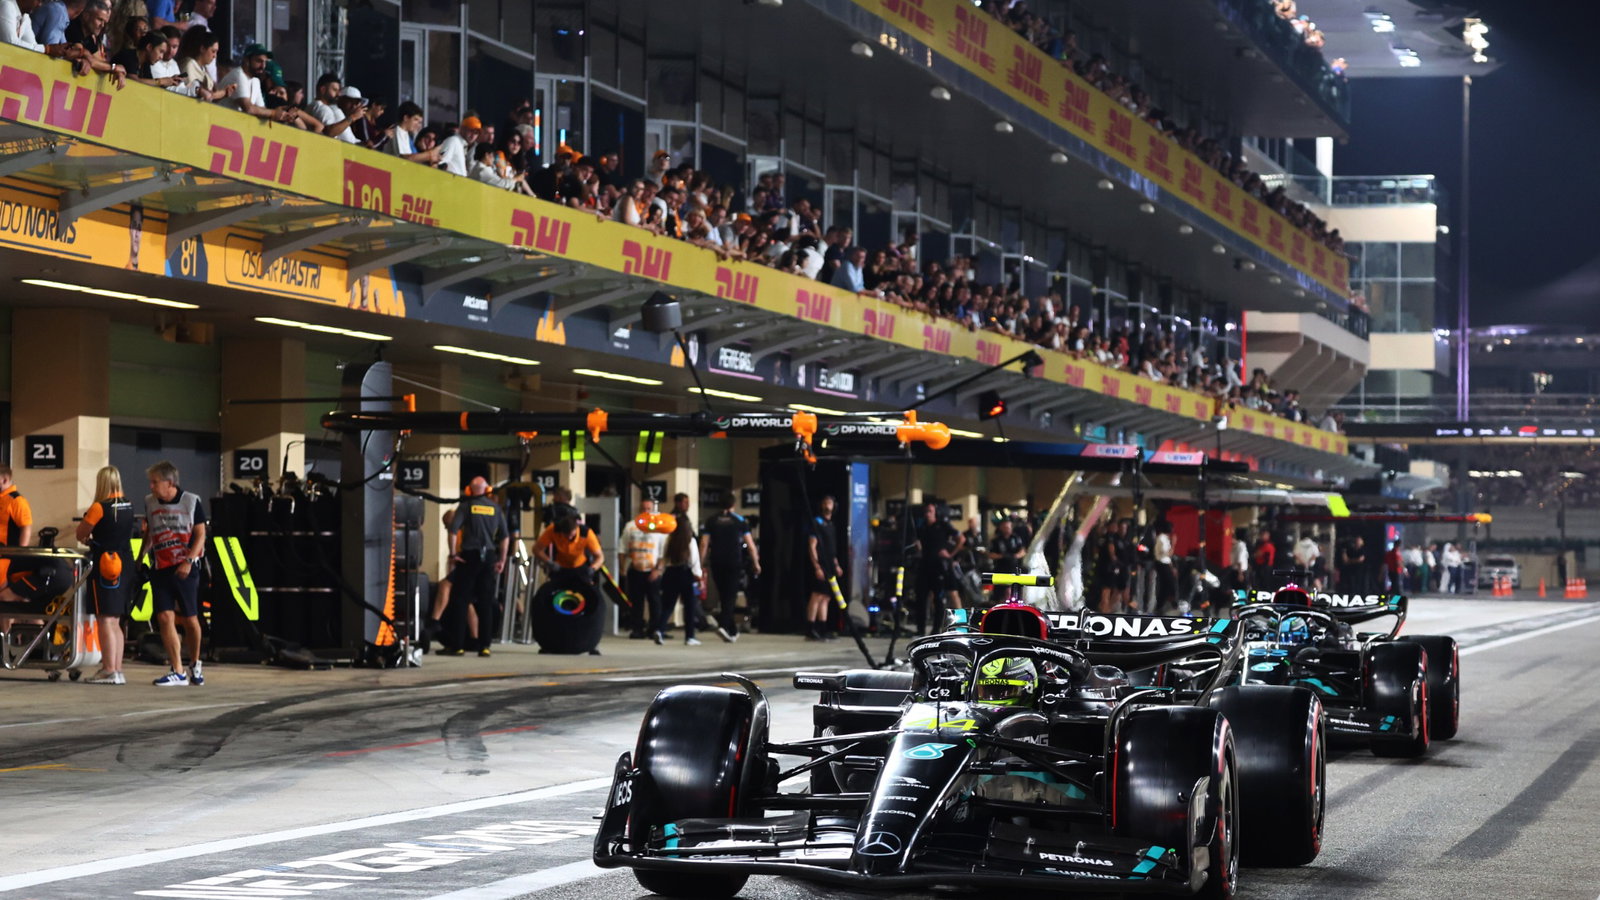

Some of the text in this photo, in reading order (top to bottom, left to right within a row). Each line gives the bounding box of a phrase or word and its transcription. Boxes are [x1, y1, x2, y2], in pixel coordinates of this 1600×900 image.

[0, 200, 23, 233] DO
[280, 256, 321, 290] PIASTRI
[732, 418, 793, 428] DP WORLD
[841, 425, 897, 435] DP WORLD
[33, 443, 56, 459] 21
[240, 457, 263, 471] 20
[404, 468, 423, 480] 19
[1039, 852, 1114, 867] PETRONAS
